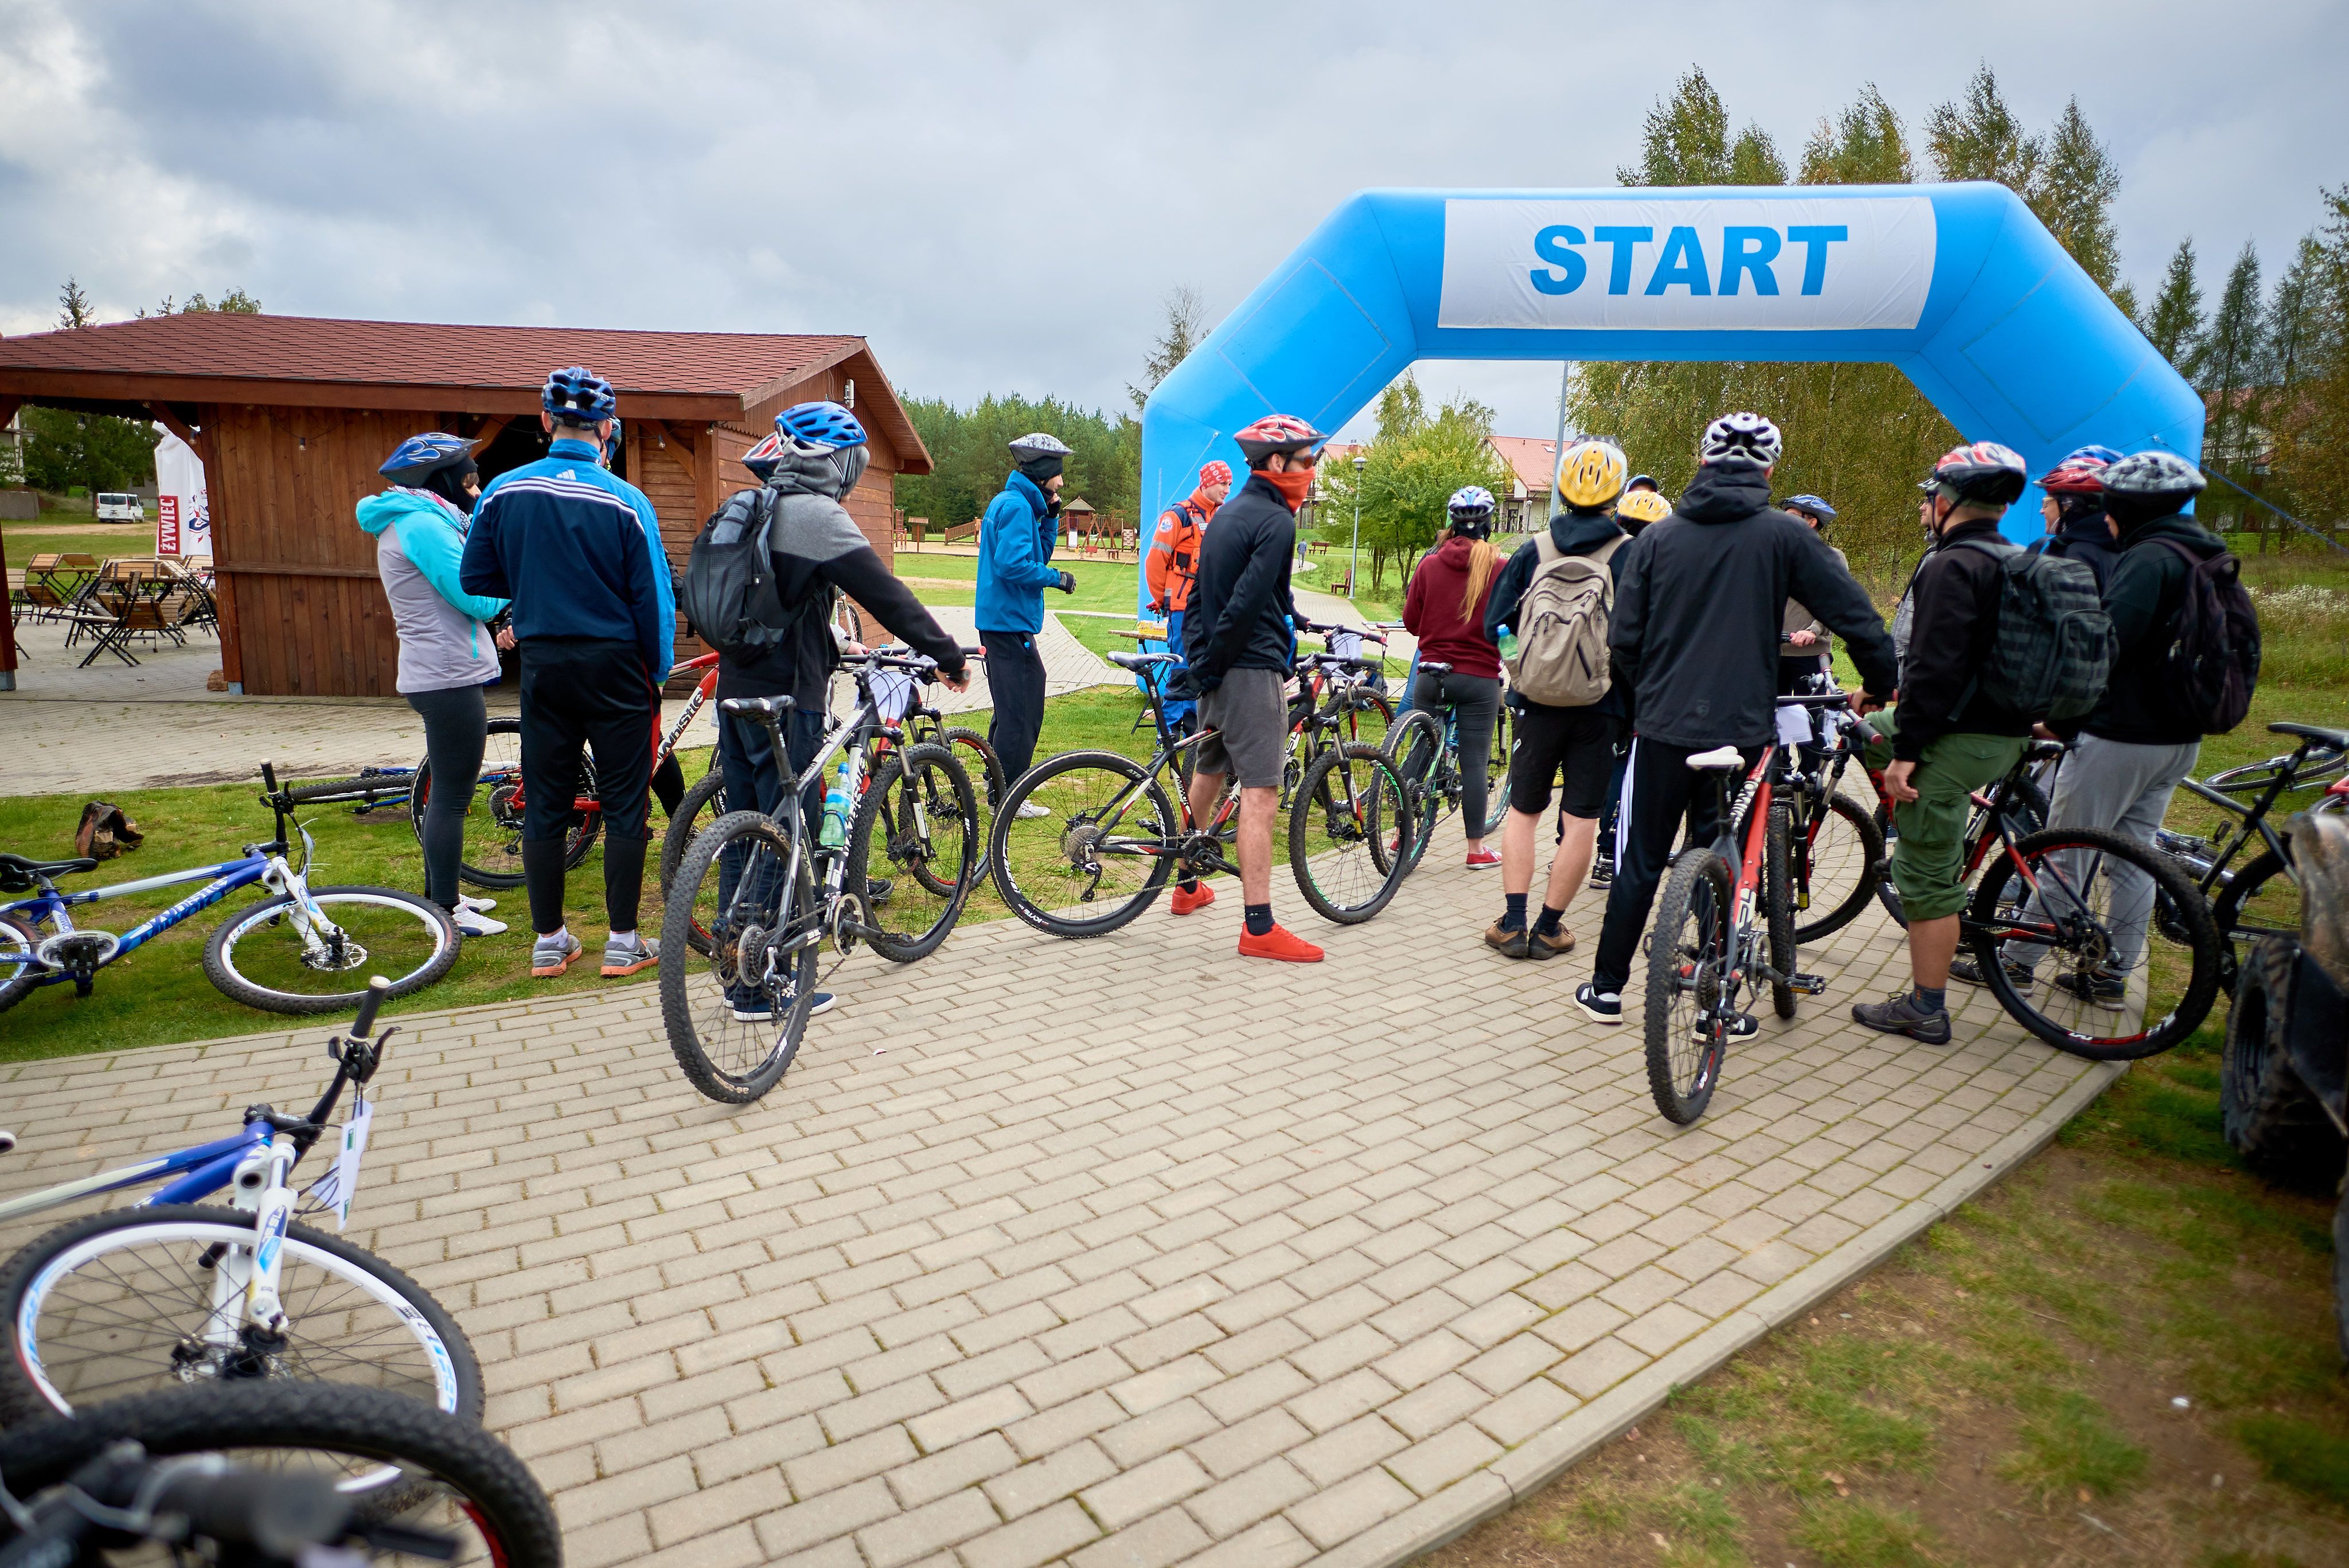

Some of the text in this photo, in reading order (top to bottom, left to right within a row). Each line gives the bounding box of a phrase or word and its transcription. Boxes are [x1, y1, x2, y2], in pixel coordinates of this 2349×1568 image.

[1530, 225, 1848, 296] START
[161, 498, 177, 551] ŻYWIEC
[1177, 778, 1189, 808] MIWOK
